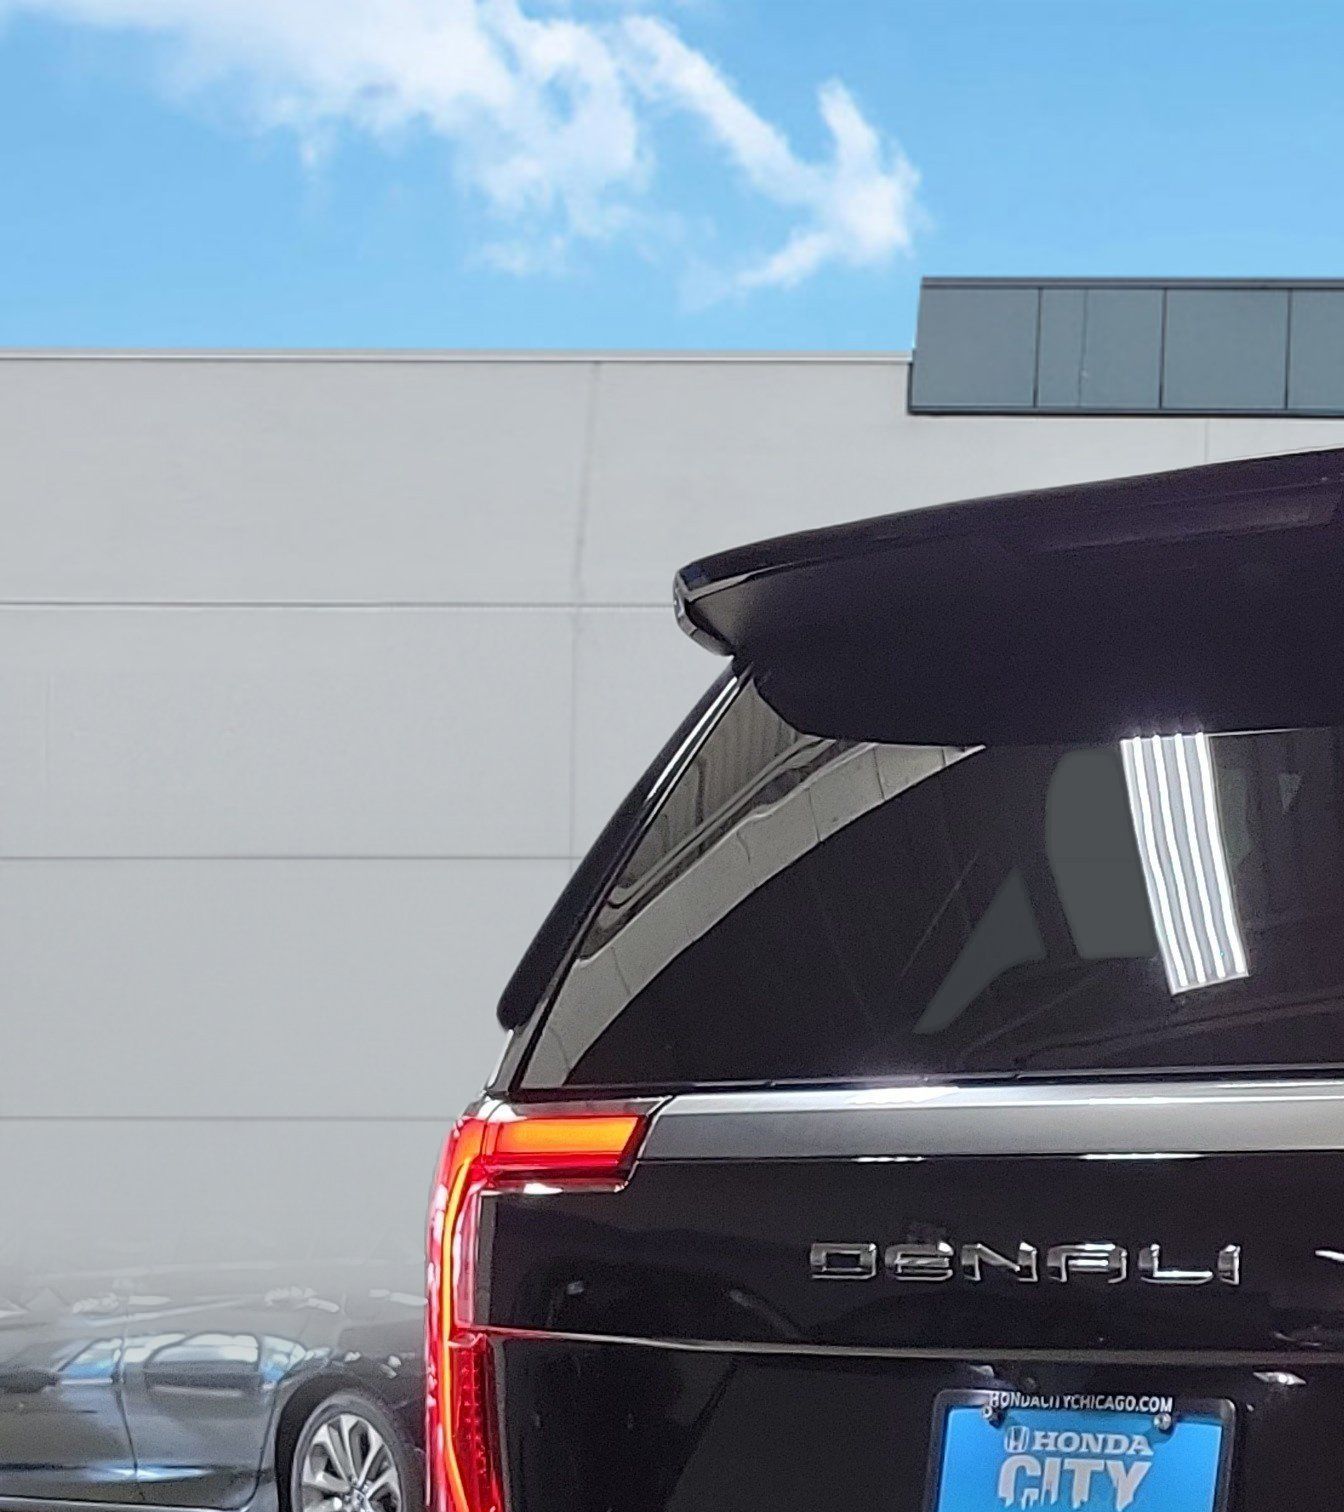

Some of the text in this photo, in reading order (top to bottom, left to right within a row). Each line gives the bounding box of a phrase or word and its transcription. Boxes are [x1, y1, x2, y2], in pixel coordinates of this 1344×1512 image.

[810, 1241, 1241, 1284] DENALI
[990, 1391, 1173, 1412] HONDACITYCHICAGO.COM
[1033, 1431, 1154, 1456] HONDA
[998, 1455, 1151, 1512] CITY
